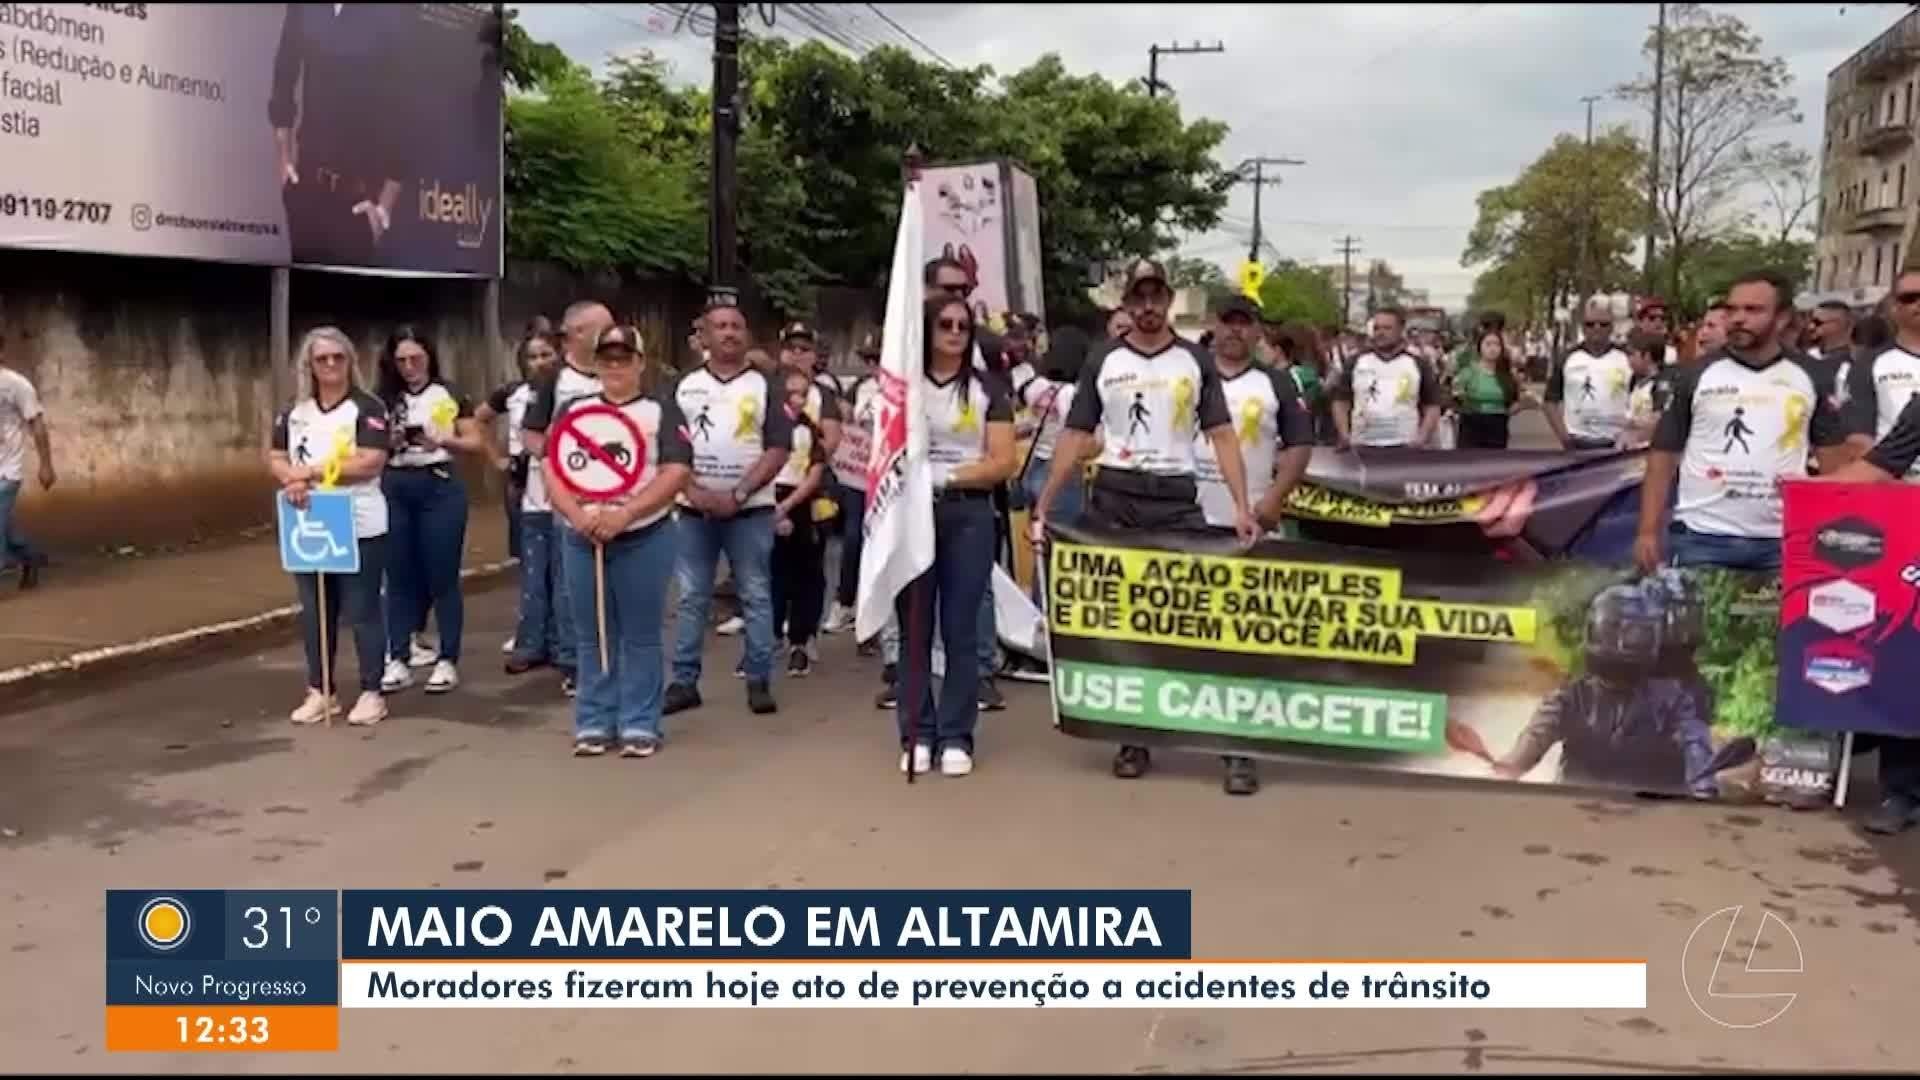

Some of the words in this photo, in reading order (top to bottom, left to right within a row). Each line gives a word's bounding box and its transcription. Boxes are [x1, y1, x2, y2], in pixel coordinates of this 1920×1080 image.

[2, 70, 62, 106] facial
[119, 64, 132, 84] e
[0, 193, 112, 224] 9119-2707
[419, 177, 493, 240] ideally
[1057, 550, 1124, 579] UMA
[1241, 565, 1382, 599] SIMPLES
[1055, 577, 1120, 604] QUE
[1128, 583, 1212, 612] PODE
[1222, 591, 1347, 624] SALVAR
[1357, 602, 1425, 629] SUA
[1434, 608, 1515, 636] VIDA
[1055, 602, 1072, 625] E
[1082, 605, 1120, 630] DE
[1130, 609, 1222, 641] QUEM
[1328, 628, 1404, 656] AMA
[1056, 667, 1144, 713] USE
[1158, 680, 1434, 740] CAPACETE!
